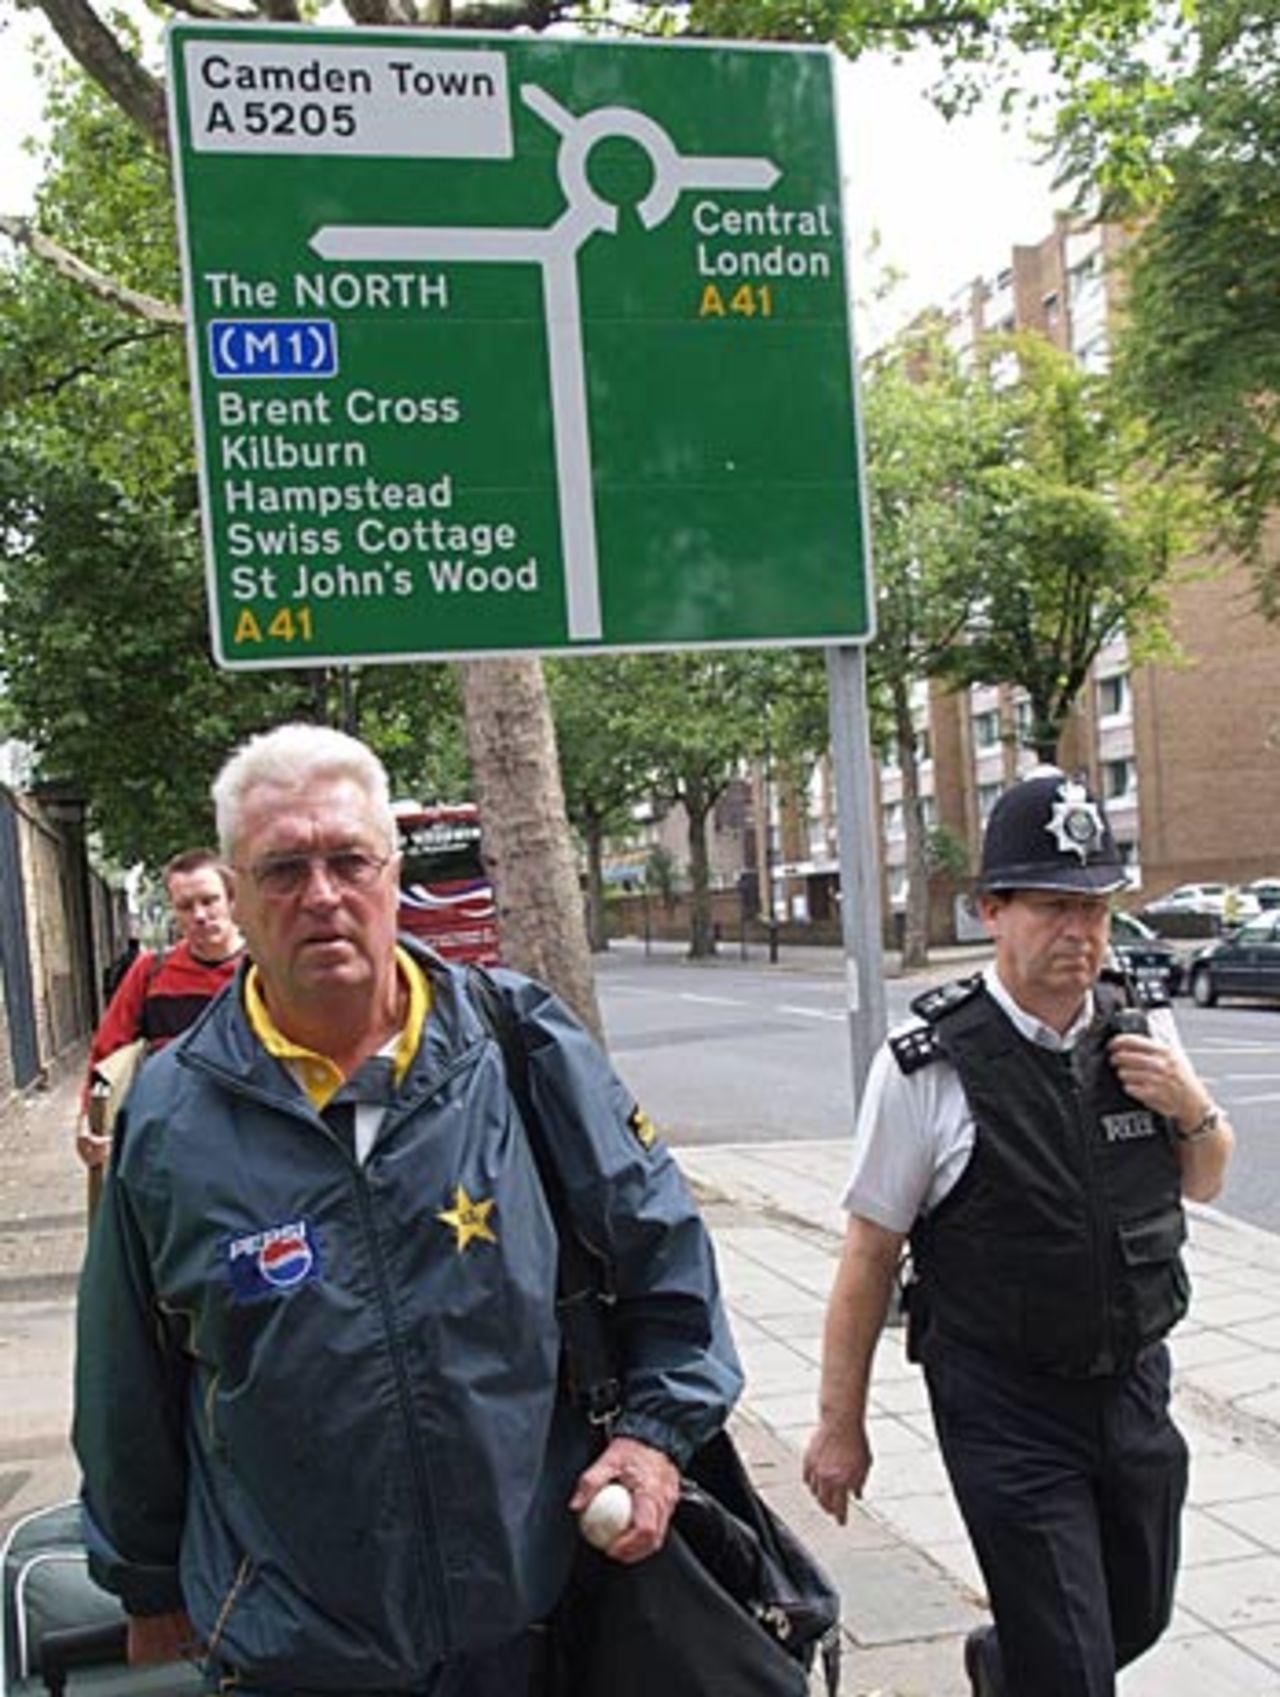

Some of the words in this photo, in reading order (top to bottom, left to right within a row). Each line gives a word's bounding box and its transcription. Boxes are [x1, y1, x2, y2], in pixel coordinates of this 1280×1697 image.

[201, 55, 372, 94] Camden
[388, 62, 495, 97] Town
[206, 100, 357, 137] A5205
[692, 200, 832, 236] Central
[697, 243, 830, 277] London
[204, 272, 278, 307] The
[295, 273, 448, 308] NORTH
[219, 326, 327, 370] (M1)
[219, 391, 331, 425] Brent
[347, 390, 460, 423] Cross
[222, 435, 366, 469] Kilburn
[225, 475, 452, 516] Hampstead
[228, 523, 341, 557] Swiss
[357, 519, 516, 556] Cottage
[232, 566, 276, 600] St
[292, 562, 412, 598] John's
[428, 557, 538, 592] Wood
